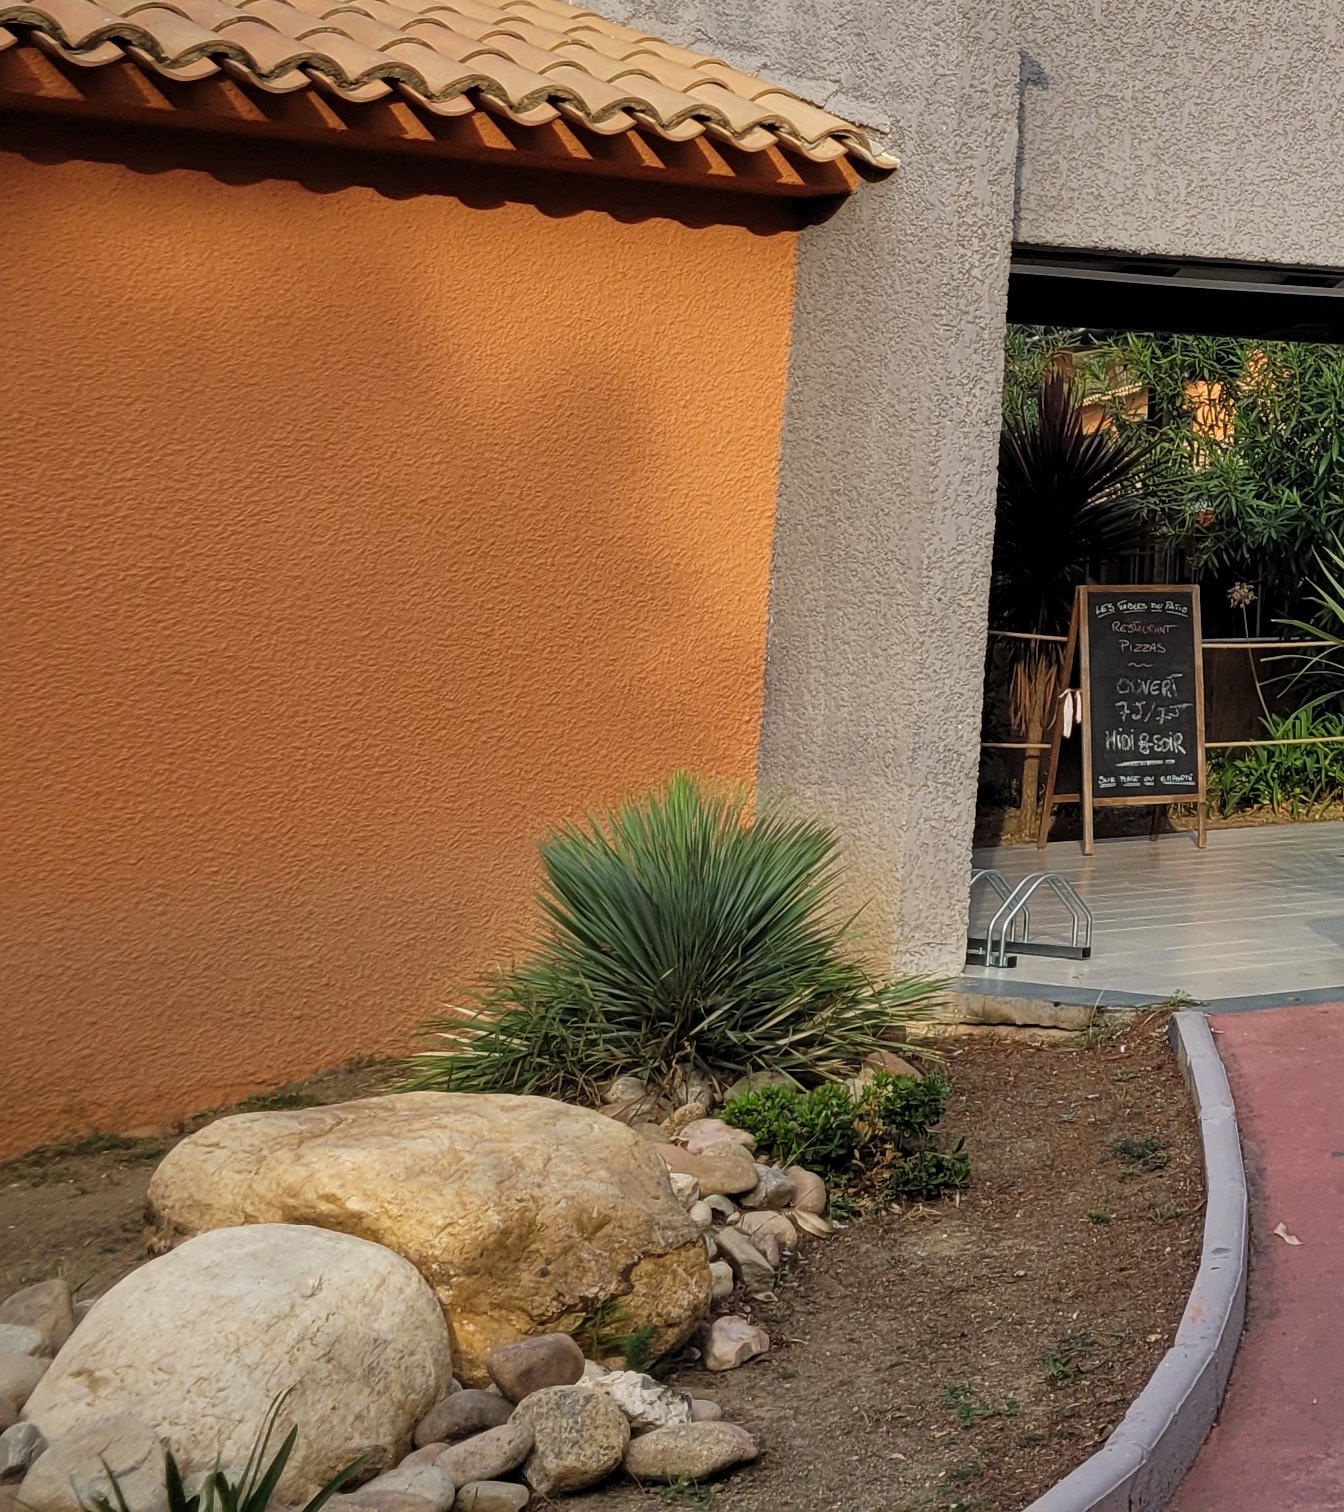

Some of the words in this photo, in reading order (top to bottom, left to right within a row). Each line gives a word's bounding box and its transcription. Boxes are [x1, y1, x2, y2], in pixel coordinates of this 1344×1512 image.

[1095, 602, 1116, 615] LES
[1116, 599, 1148, 611] TABLES
[1150, 602, 1164, 610] DU
[1164, 600, 1188, 614] PATIO
[1111, 620, 1179, 635] RESTAURANT
[1118, 638, 1167, 653] PIZZAS
[1116, 673, 1184, 698] OUVERT
